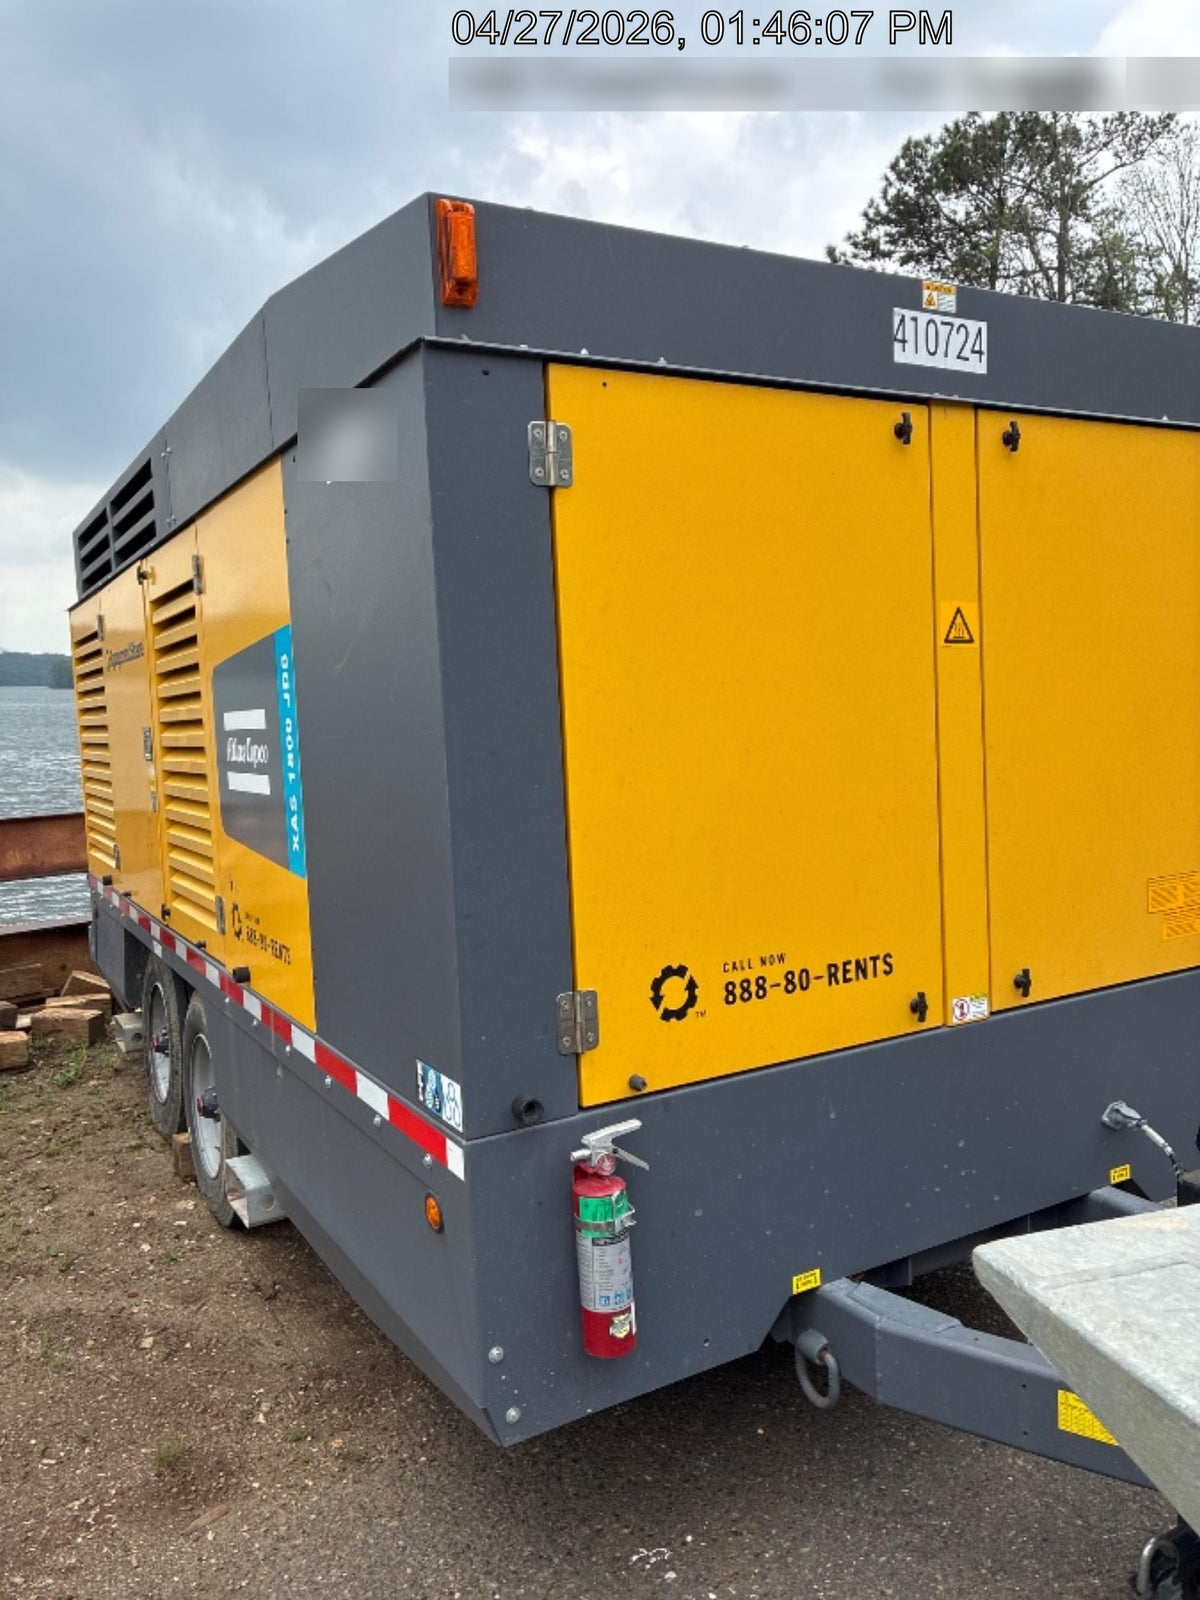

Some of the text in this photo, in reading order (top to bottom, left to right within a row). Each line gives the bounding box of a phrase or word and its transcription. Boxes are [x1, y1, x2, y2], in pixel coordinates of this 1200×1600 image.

[893, 314, 985, 364] 410724
[722, 952, 787, 974] CALL NOW
[724, 952, 894, 1006] 888-80-RENTS
